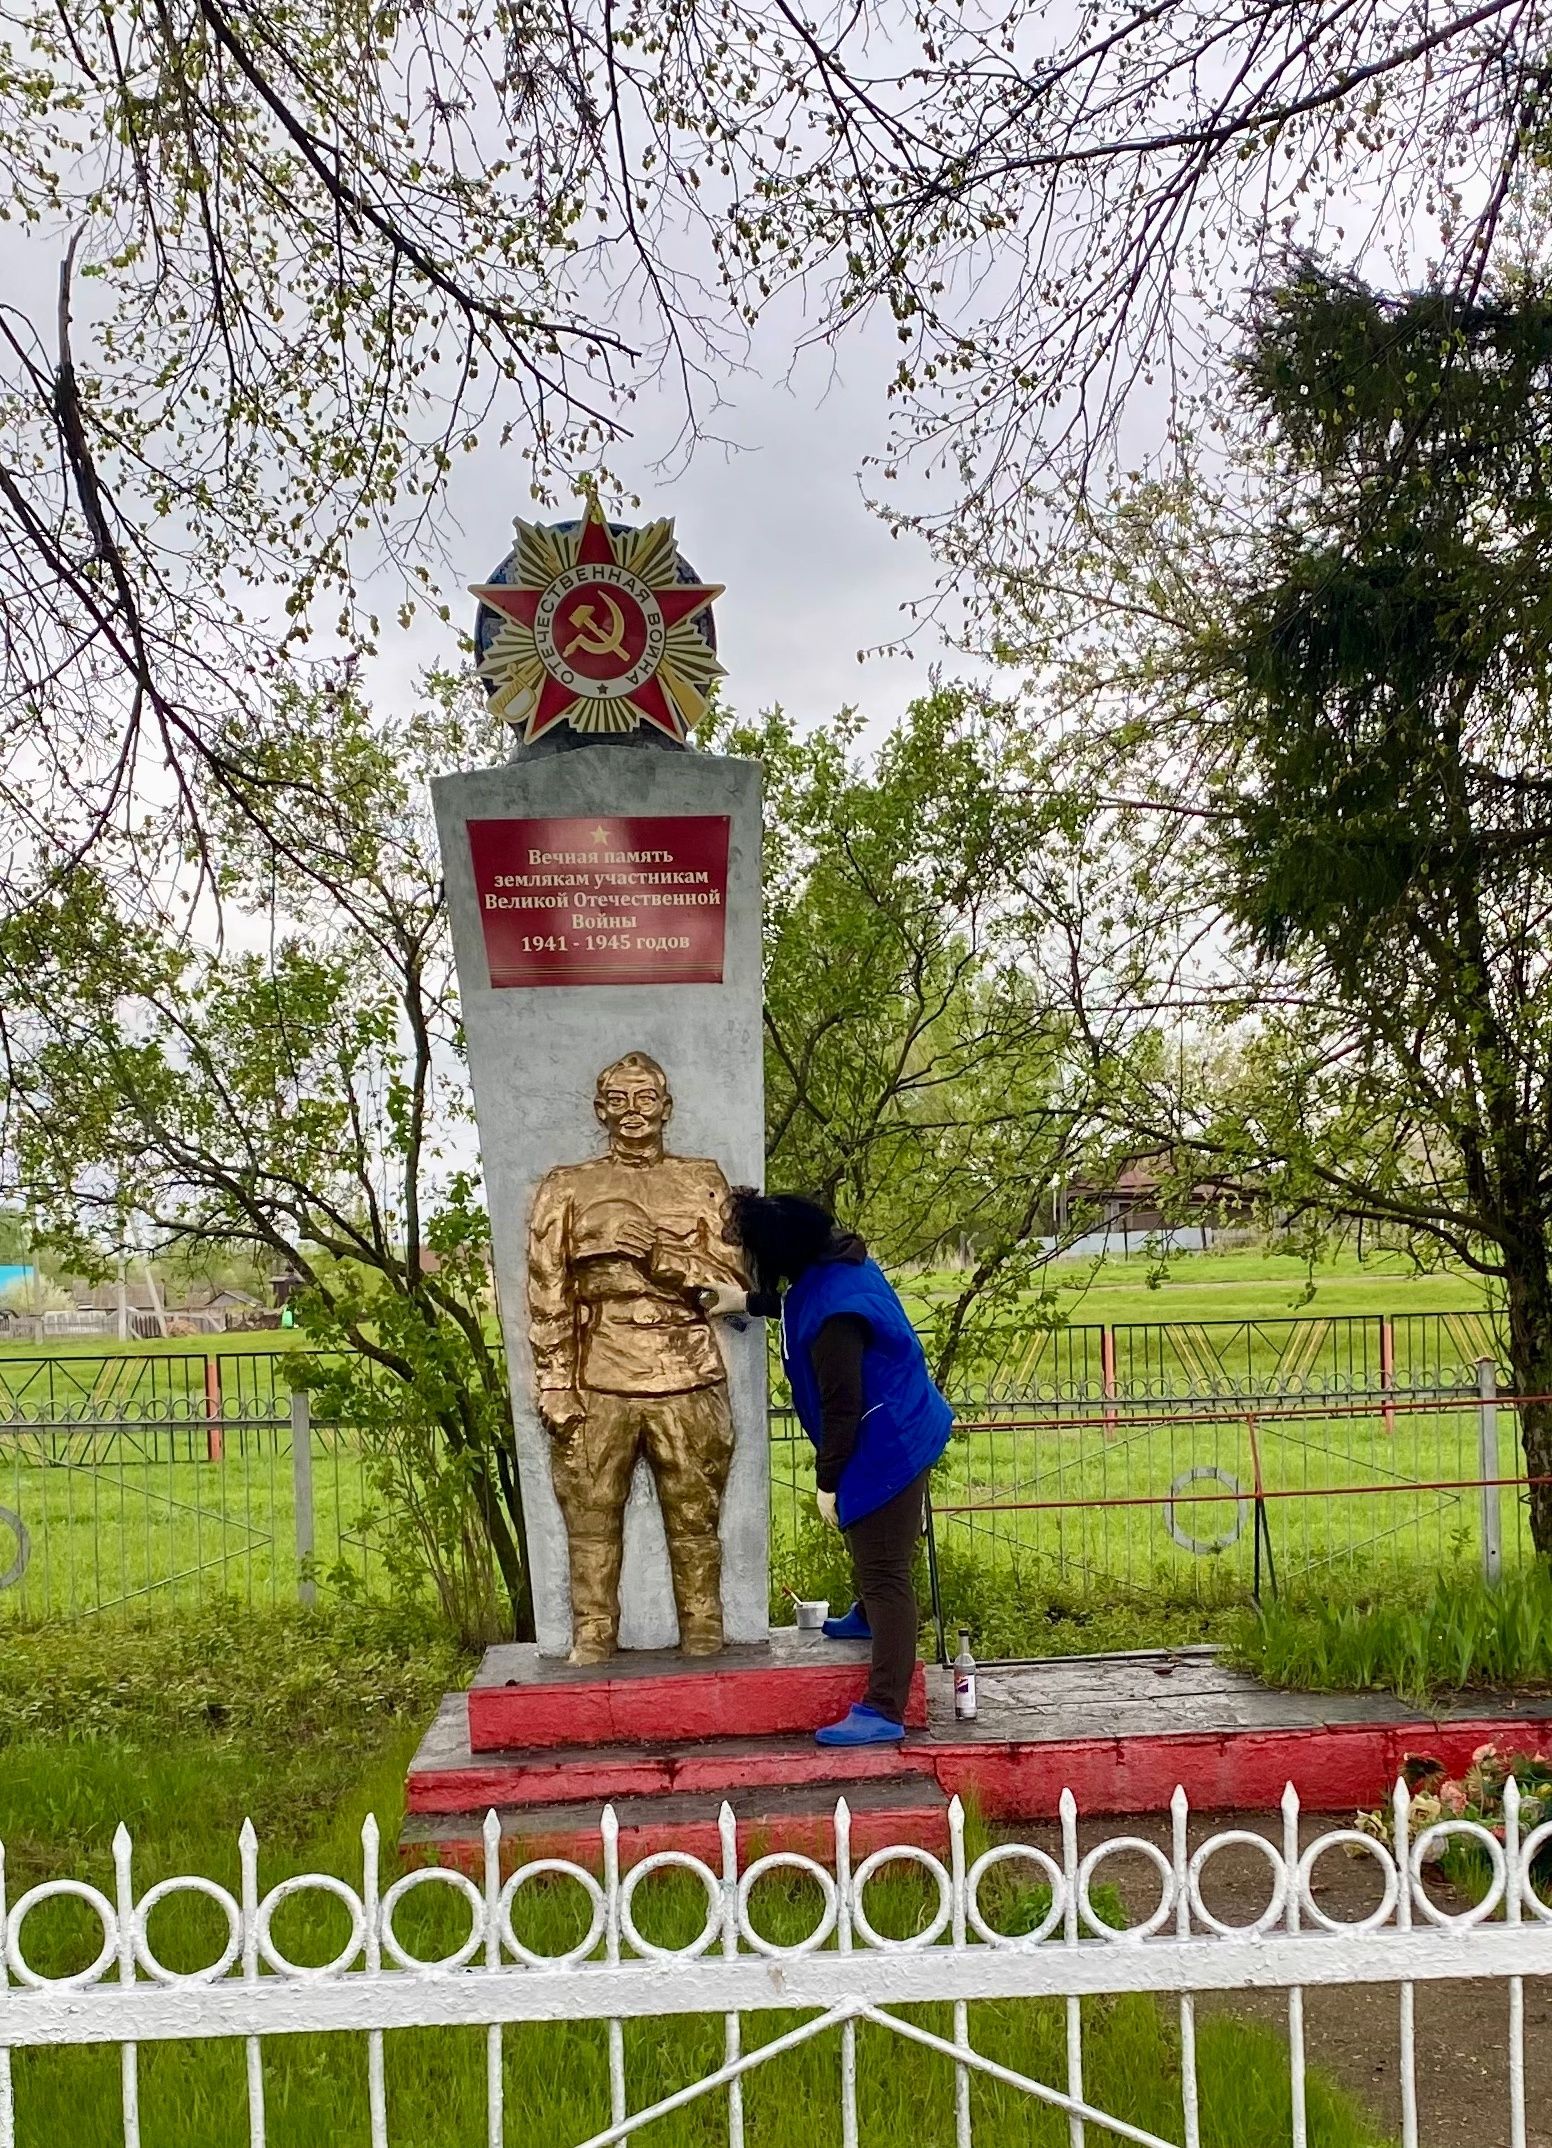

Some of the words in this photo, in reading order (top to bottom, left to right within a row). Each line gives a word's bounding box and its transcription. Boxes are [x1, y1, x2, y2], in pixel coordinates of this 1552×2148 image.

[537, 566, 650, 685] ОТЕЧЕСТВЕННАЯ
[528, 850, 598, 866] Вечная
[604, 850, 674, 865] память
[494, 873, 590, 888] землякам
[594, 870, 709, 889] участникам
[485, 892, 569, 910] Великой
[573, 889, 721, 907] Отечественной
[571, 914, 637, 930] Войны
[521, 935, 568, 952] 1941
[585, 934, 631, 951] 1945
[636, 935, 690, 951] годов
